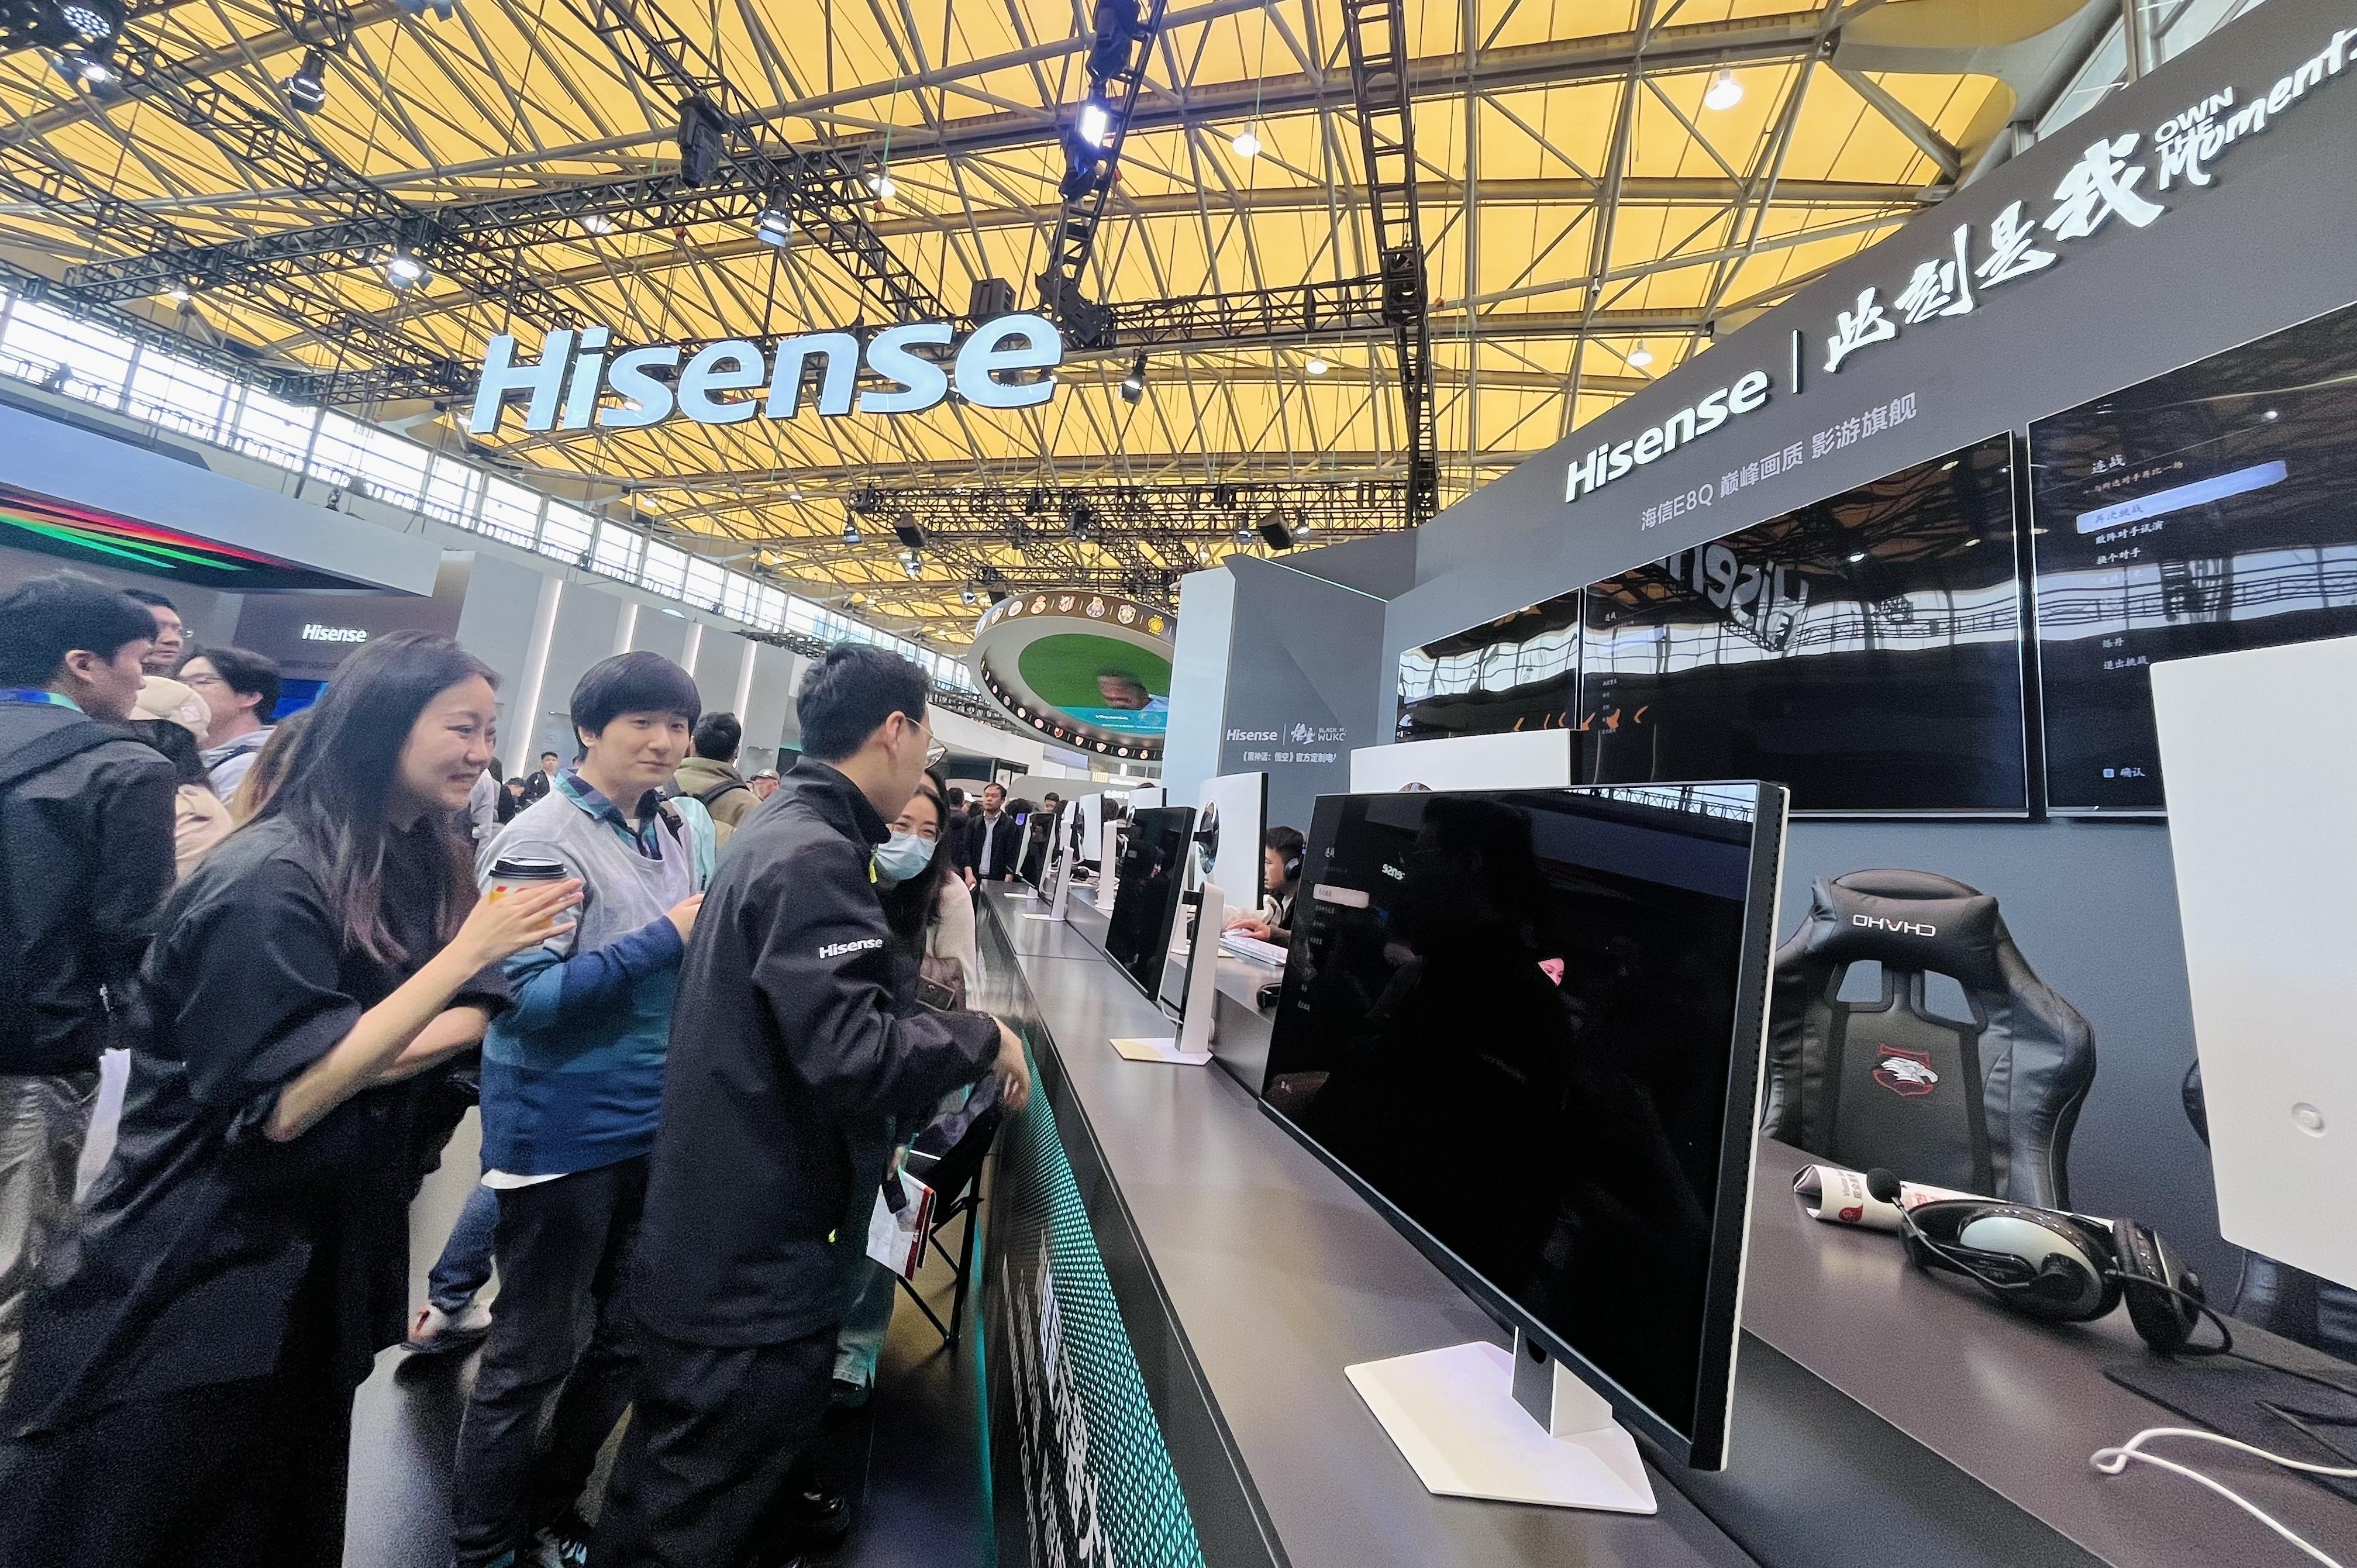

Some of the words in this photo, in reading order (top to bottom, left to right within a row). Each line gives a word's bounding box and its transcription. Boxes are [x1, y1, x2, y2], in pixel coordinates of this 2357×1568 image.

[2155, 86, 2234, 143] OWN
[2158, 27, 2357, 191] Moment
[2155, 116, 2214, 159] THE
[1823, 132, 2165, 373] 此刻是我
[470, 313, 1063, 435] Hisense
[1564, 370, 1769, 504] Hisense
[1641, 483, 1714, 531] 海信E8Q
[1720, 440, 1804, 498] 巅峰画质
[1811, 392, 1917, 460] 影游旗舰
[2091, 454, 2126, 475] 连战
[302, 623, 367, 643] Hisense
[1226, 729, 1278, 742] Hisense
[2119, 767, 2146, 778] 确认
[819, 938, 884, 960] Hisense
